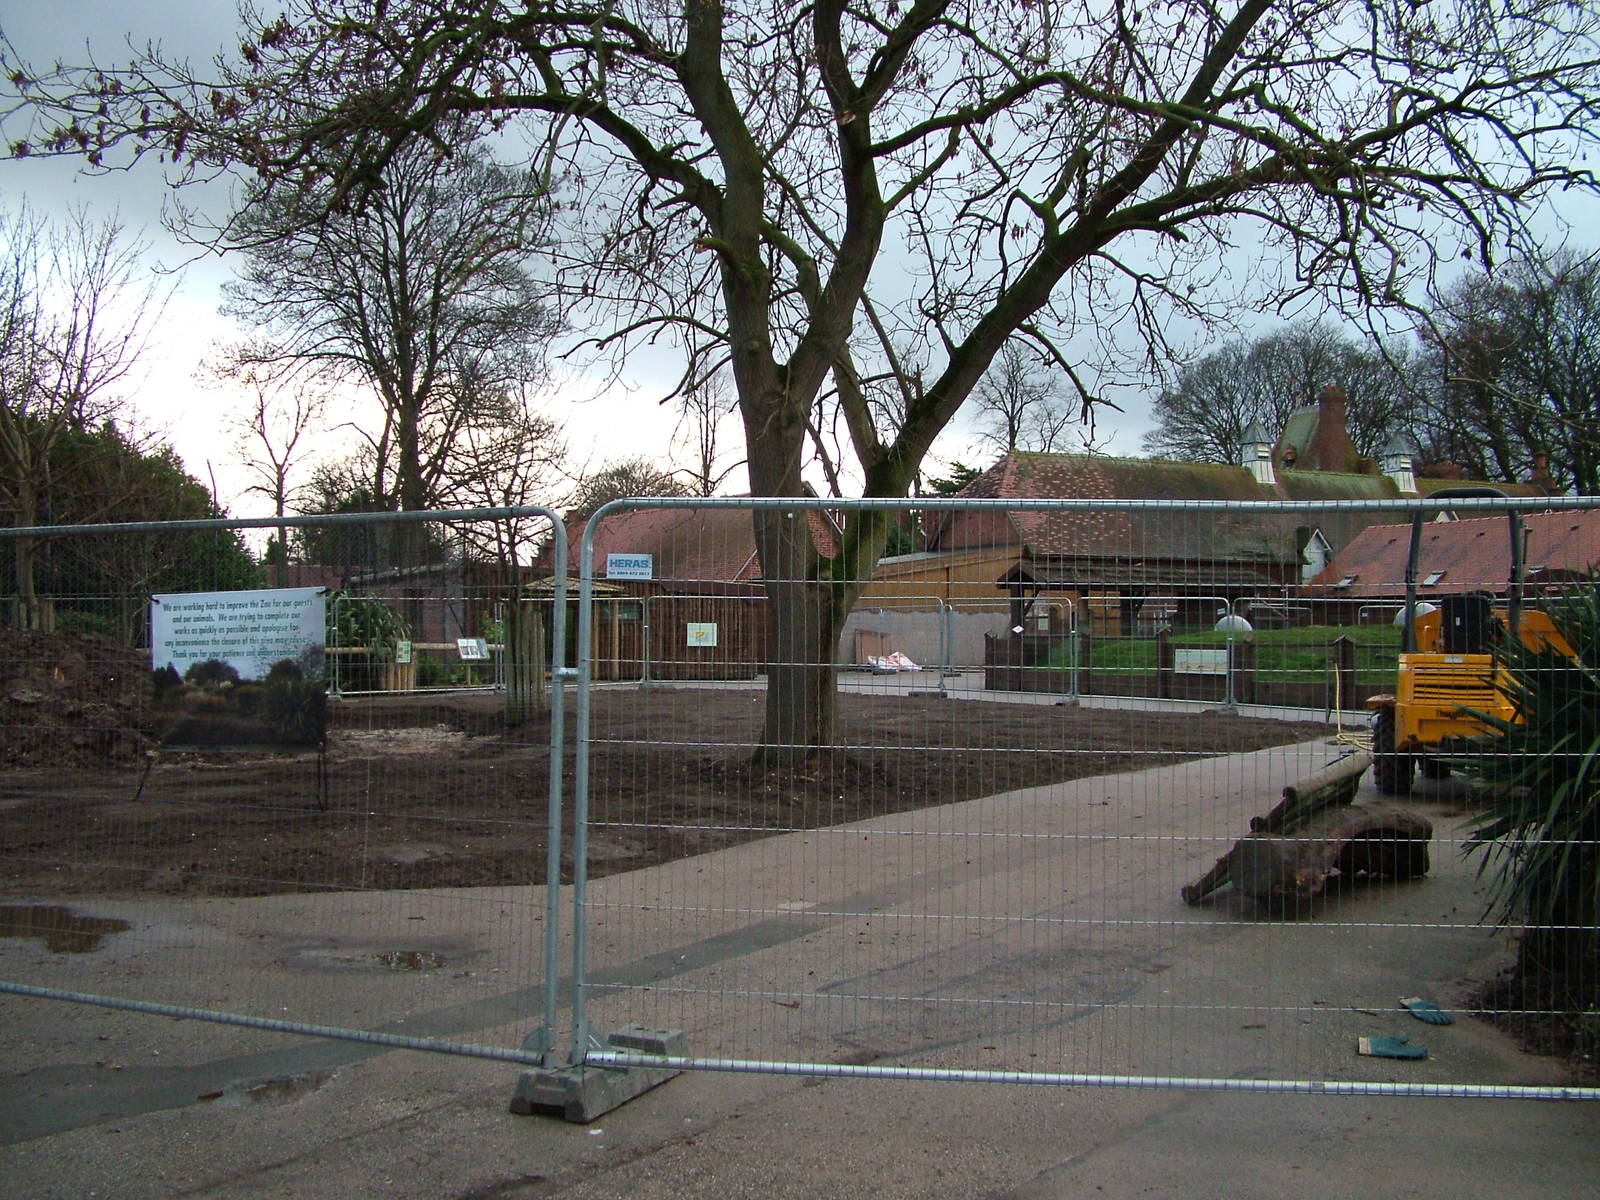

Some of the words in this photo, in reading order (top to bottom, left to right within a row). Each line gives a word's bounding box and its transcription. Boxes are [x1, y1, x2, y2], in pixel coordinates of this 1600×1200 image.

[183, 602, 205, 613] working
[206, 601, 218, 610] hard
[227, 601, 248, 611] improve
[250, 600, 258, 608] the
[260, 600, 271, 608] Zoo
[273, 599, 281, 607] for
[173, 615, 182, 623] and
[265, 611, 289, 621] complete
[199, 625, 217, 635] quickly
[226, 624, 248, 635] possible
[250, 624, 260, 632] and
[173, 650, 187, 658] Thank
[188, 652, 198, 660] you
